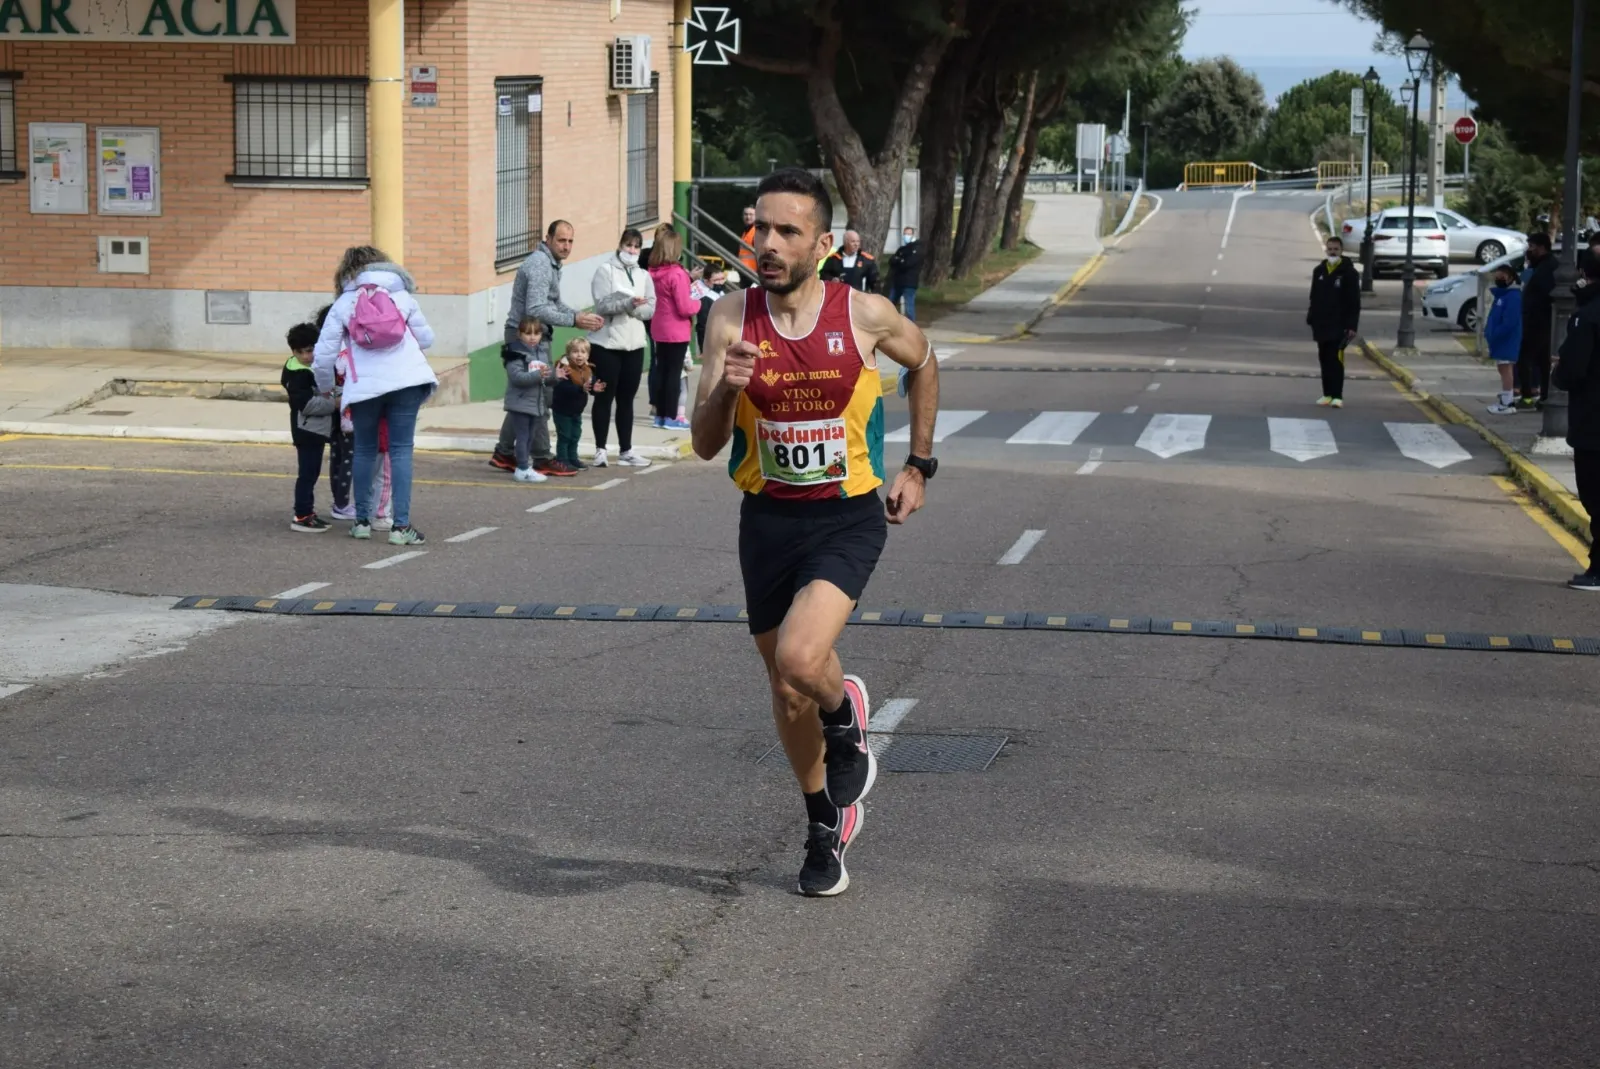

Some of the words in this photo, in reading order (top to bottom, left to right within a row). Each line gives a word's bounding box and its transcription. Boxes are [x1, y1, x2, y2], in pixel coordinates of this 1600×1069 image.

[1456, 126, 1474, 134] STOP
[783, 371, 807, 382] CAJA
[809, 369, 842, 380] RURAL
[783, 388, 821, 399] VINO
[771, 402, 790, 412] DE
[793, 400, 835, 412] TORO
[774, 443, 826, 470] 801
